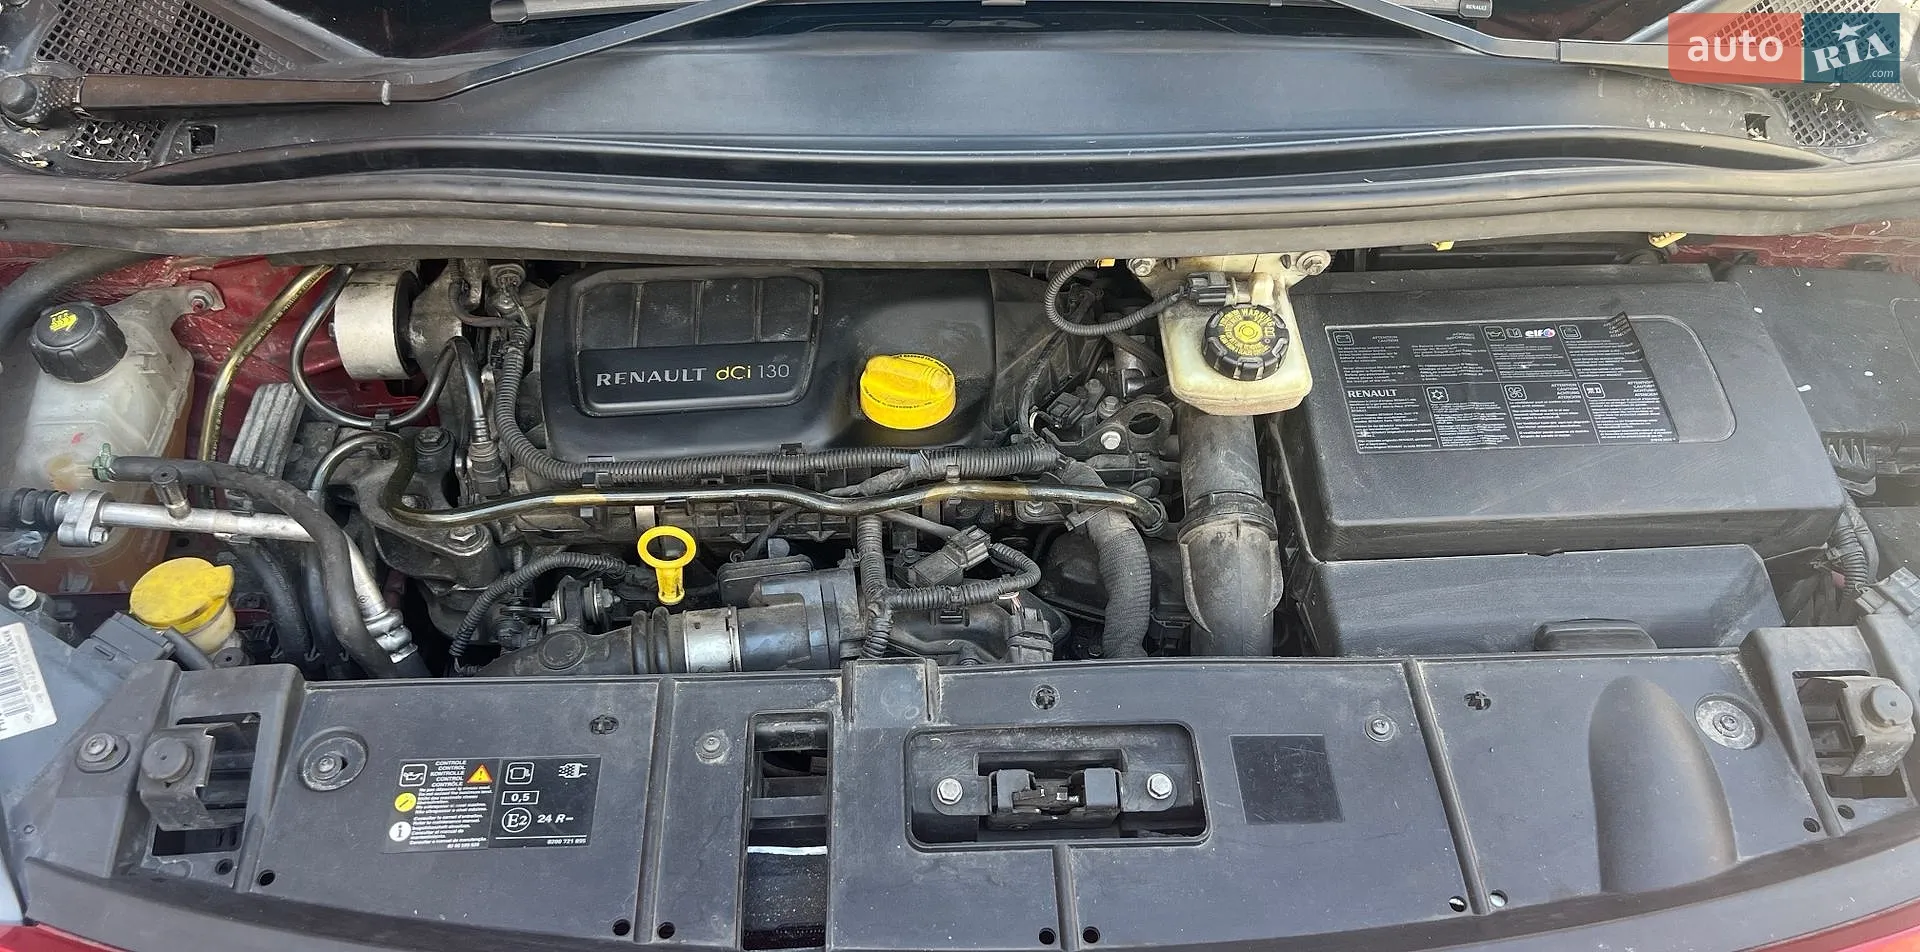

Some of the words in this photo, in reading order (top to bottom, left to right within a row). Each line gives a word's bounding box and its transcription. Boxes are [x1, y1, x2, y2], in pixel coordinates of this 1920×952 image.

[1242, 308, 1275, 327] WARNING
[596, 367, 707, 387] RENAULT
[716, 365, 752, 381] dCi
[758, 363, 790, 379] 130
[1347, 389, 1398, 398] RENAULT
[511, 793, 530, 803] 0,5
[506, 813, 528, 828] E2
[537, 814, 553, 823] 24
